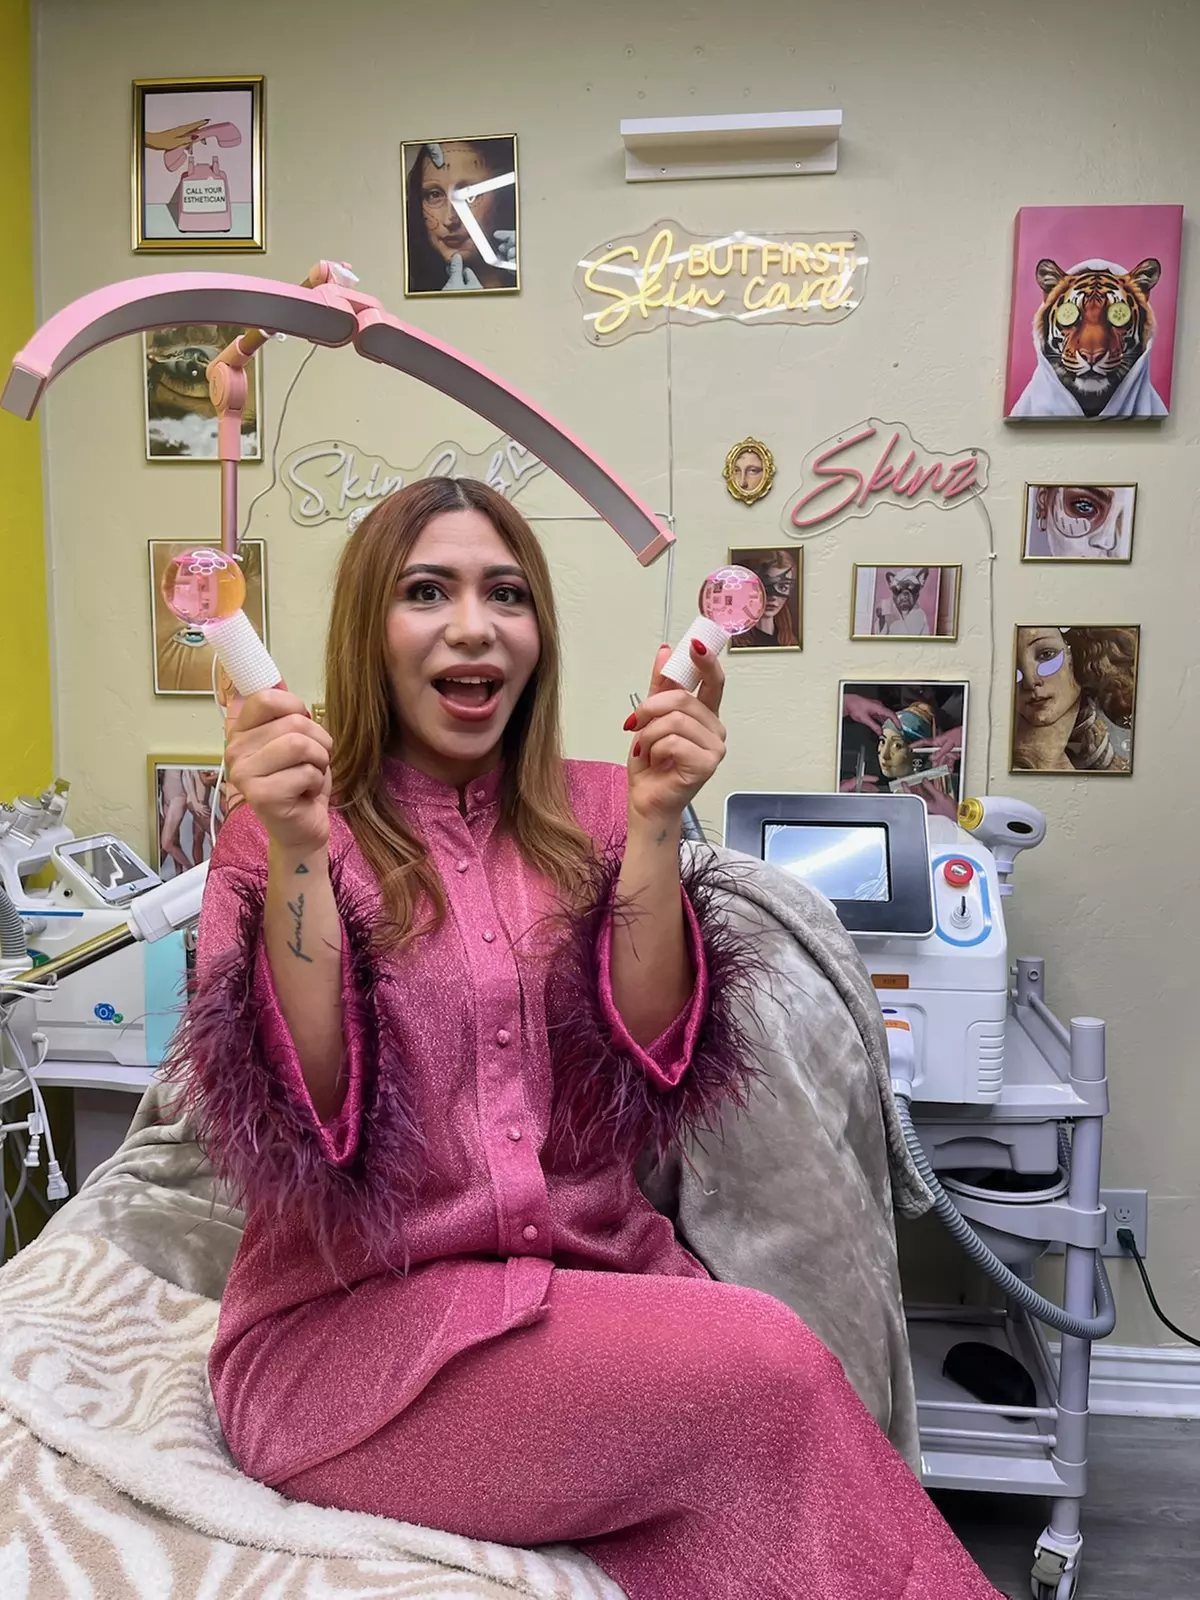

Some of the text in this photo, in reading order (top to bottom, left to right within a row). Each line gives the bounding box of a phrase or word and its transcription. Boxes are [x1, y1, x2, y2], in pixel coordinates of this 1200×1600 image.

[185, 186, 222, 195] CALL YOUR
[584, 228, 854, 334] Skin care
[688, 243, 757, 277] BUT
[288, 449, 405, 517] Skin
[790, 427, 978, 528] Skinz
